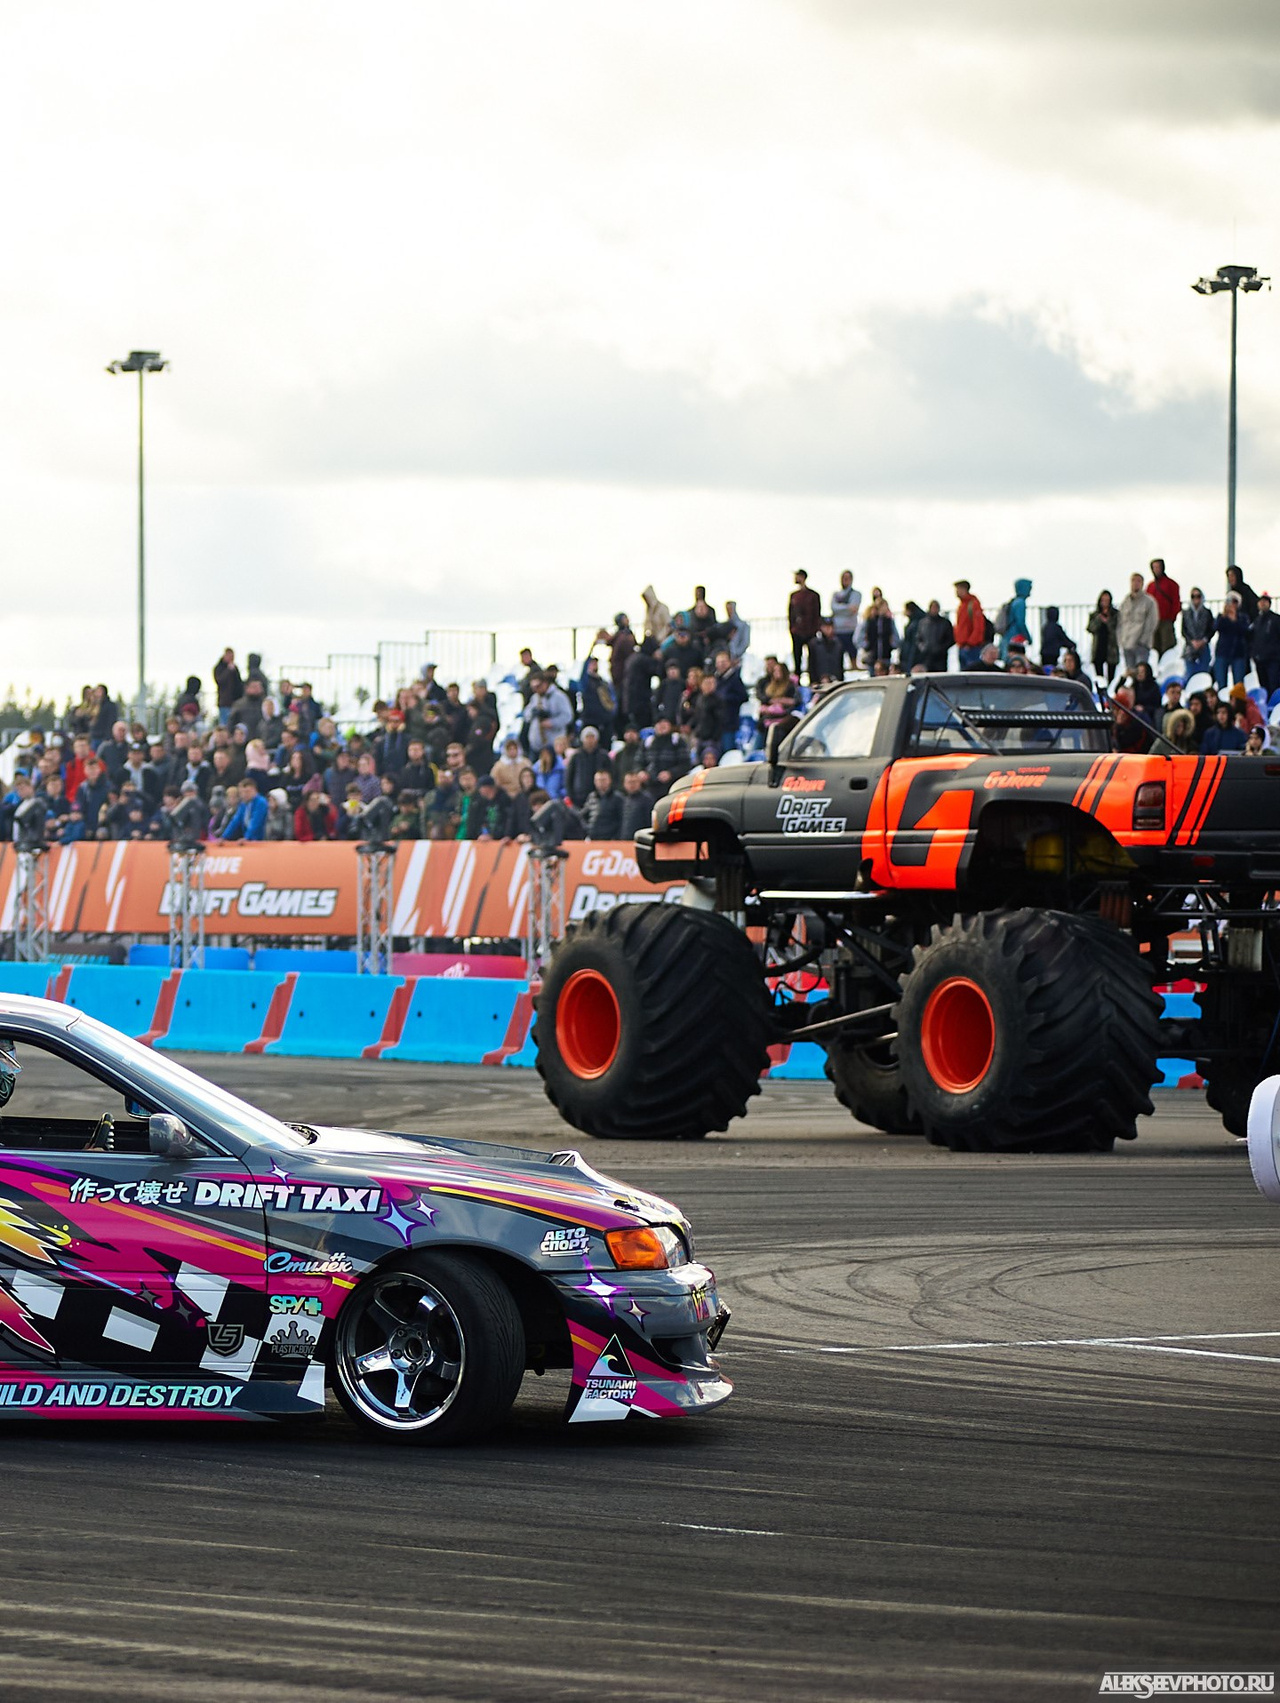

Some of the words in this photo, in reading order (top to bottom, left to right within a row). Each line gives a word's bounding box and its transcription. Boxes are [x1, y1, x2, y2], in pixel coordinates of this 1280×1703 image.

[776, 795, 832, 818] DRIFT
[783, 817, 847, 837] GAMES
[237, 880, 339, 917] GAMES
[70, 1177, 187, 1205] 作って壊せ
[194, 1181, 295, 1209] DRIFT
[301, 1186, 382, 1213] TAXI
[540, 1237, 590, 1252] СПОРТ
[544, 1227, 586, 1242] АВТО
[586, 1379, 637, 1390] TSUNAMI
[586, 1389, 637, 1399] FACTORY
[45, 1385, 109, 1406] AND
[109, 1385, 244, 1407] DESTROY
